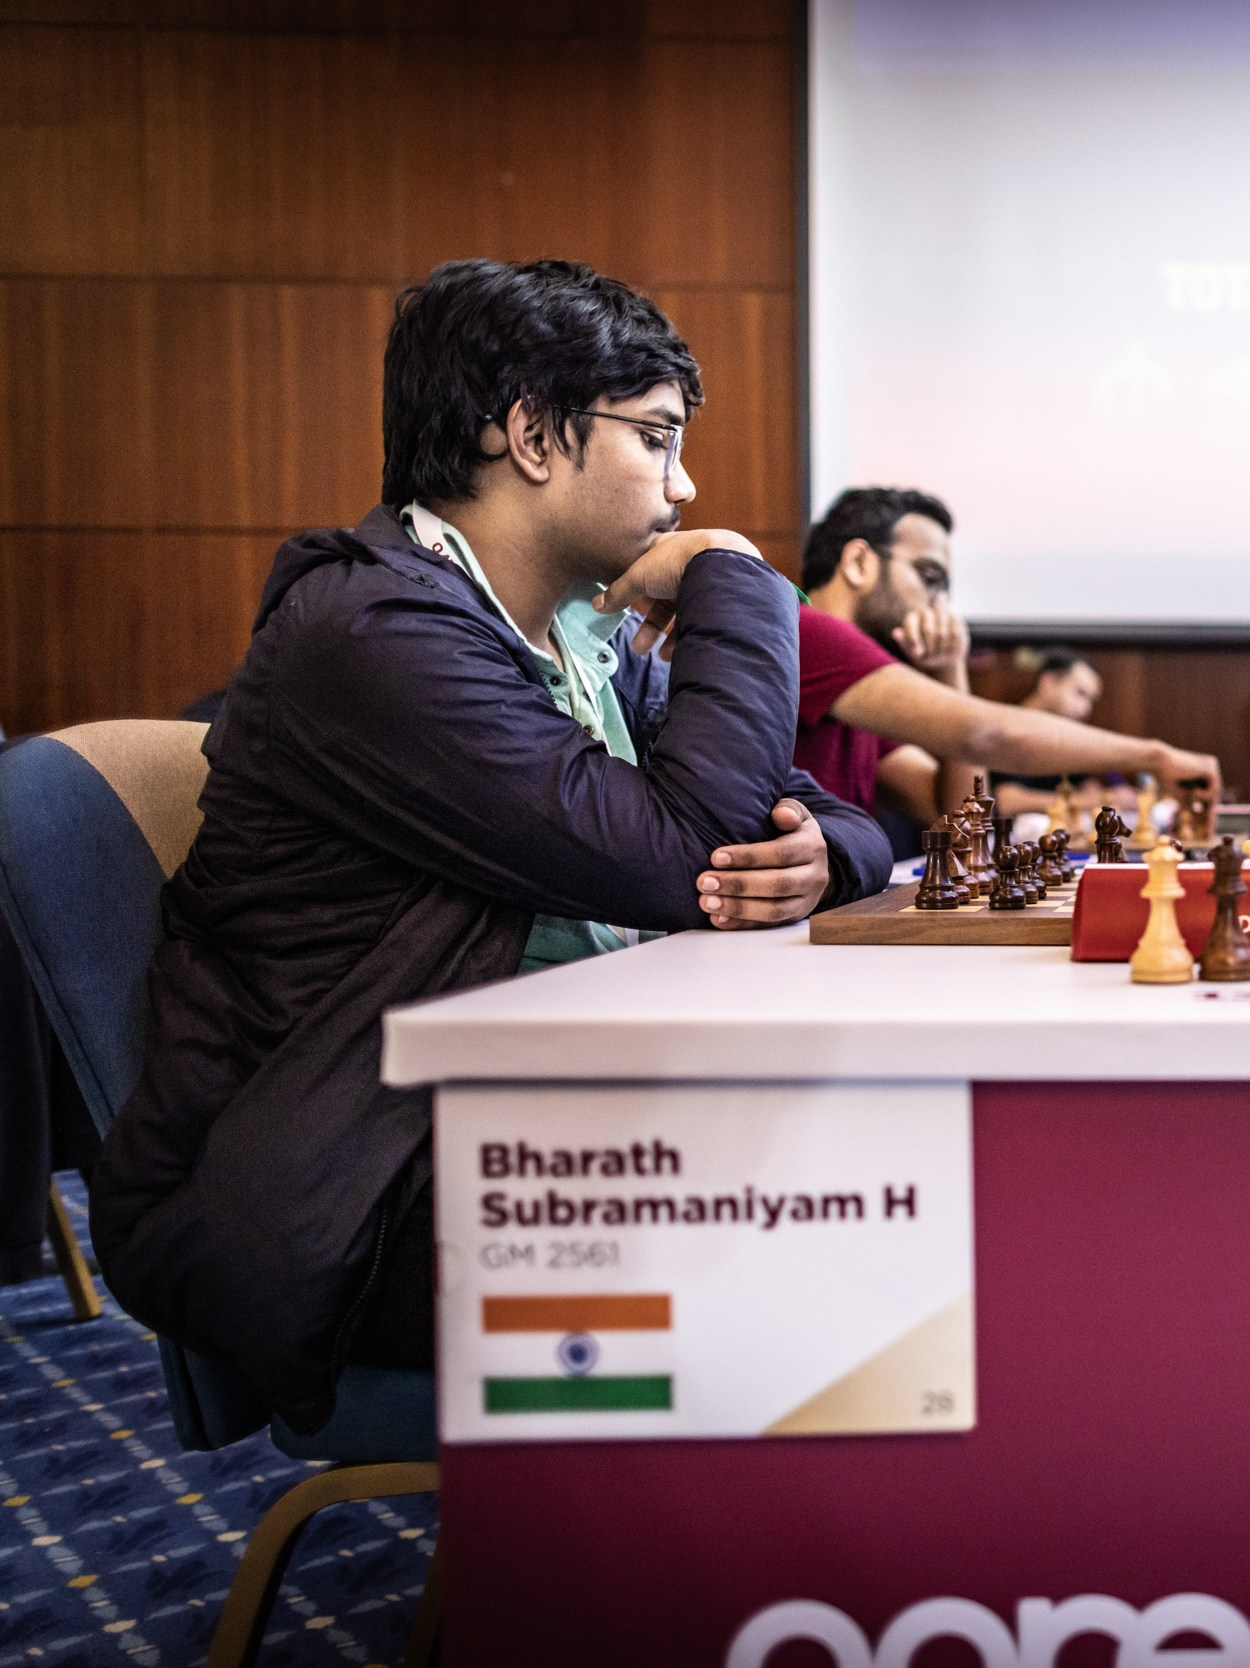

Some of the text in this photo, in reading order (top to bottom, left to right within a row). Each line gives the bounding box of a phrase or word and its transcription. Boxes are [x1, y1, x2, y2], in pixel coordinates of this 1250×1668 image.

[480, 1140, 681, 1179] Bharath
[480, 1185, 916, 1230] Subramaniyam H
[479, 1242, 619, 1269] GM 2561
[922, 1391, 954, 1414] 28
